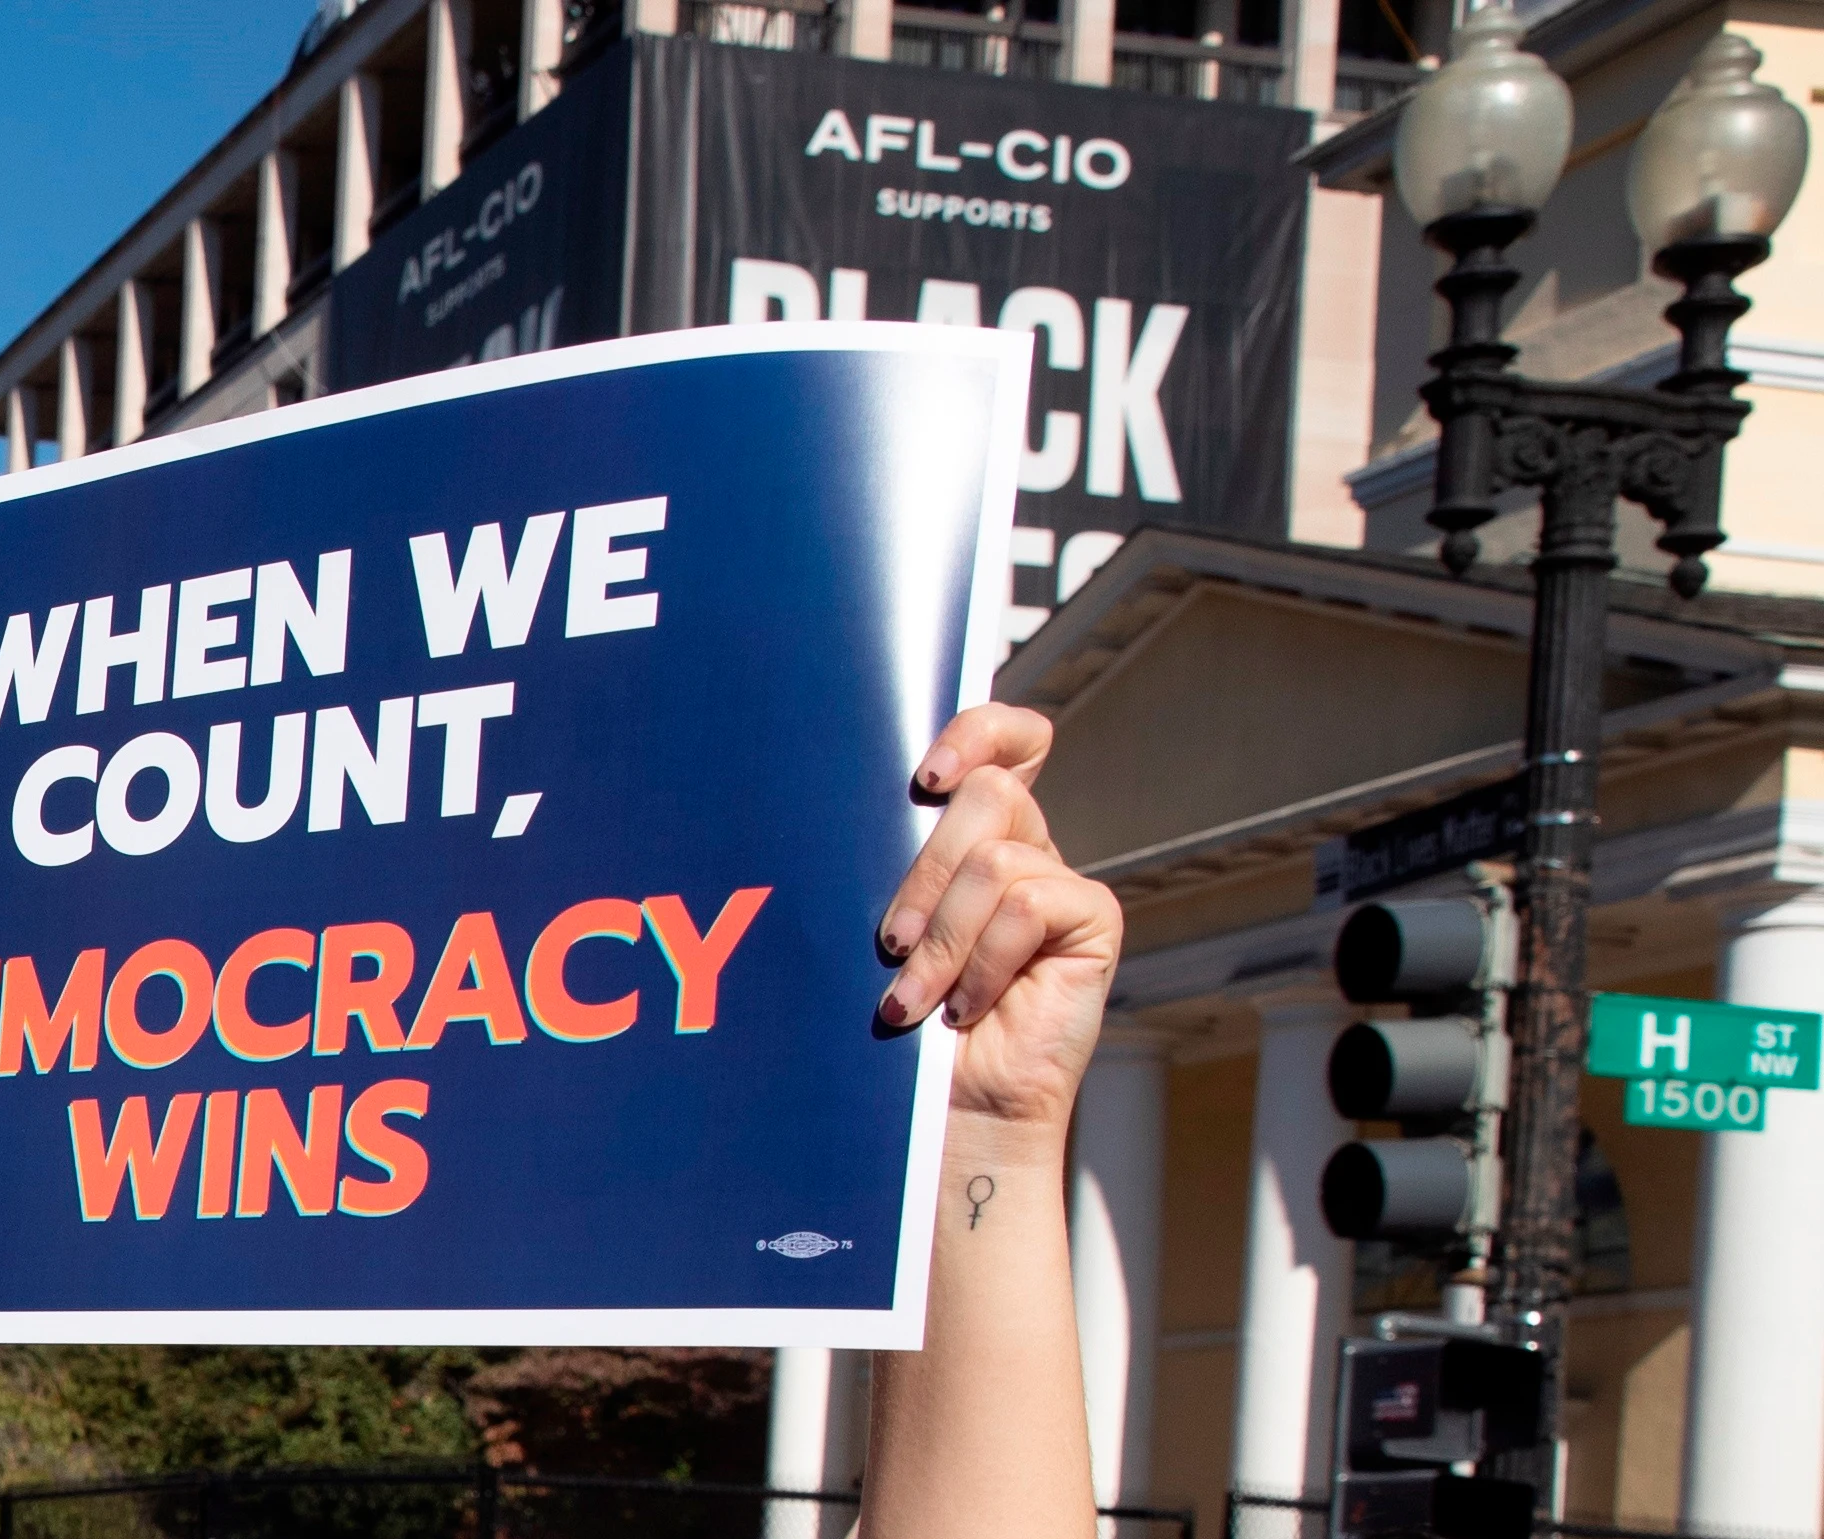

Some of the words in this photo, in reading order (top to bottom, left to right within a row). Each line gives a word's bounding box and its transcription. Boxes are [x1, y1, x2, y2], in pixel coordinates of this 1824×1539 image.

[805, 109, 1132, 190] AFL-CIO
[397, 160, 544, 305] AFL-CIO
[876, 188, 1053, 233] SUPPORTS
[409, 495, 667, 659] WE
[12, 682, 543, 867] COUNT,
[1639, 1011, 1692, 1072] H
[1755, 1021, 1798, 1050] ST
[1749, 1051, 1799, 1078] NW
[1638, 1078, 1760, 1125] 1500
[68, 1080, 430, 1222] WINS
